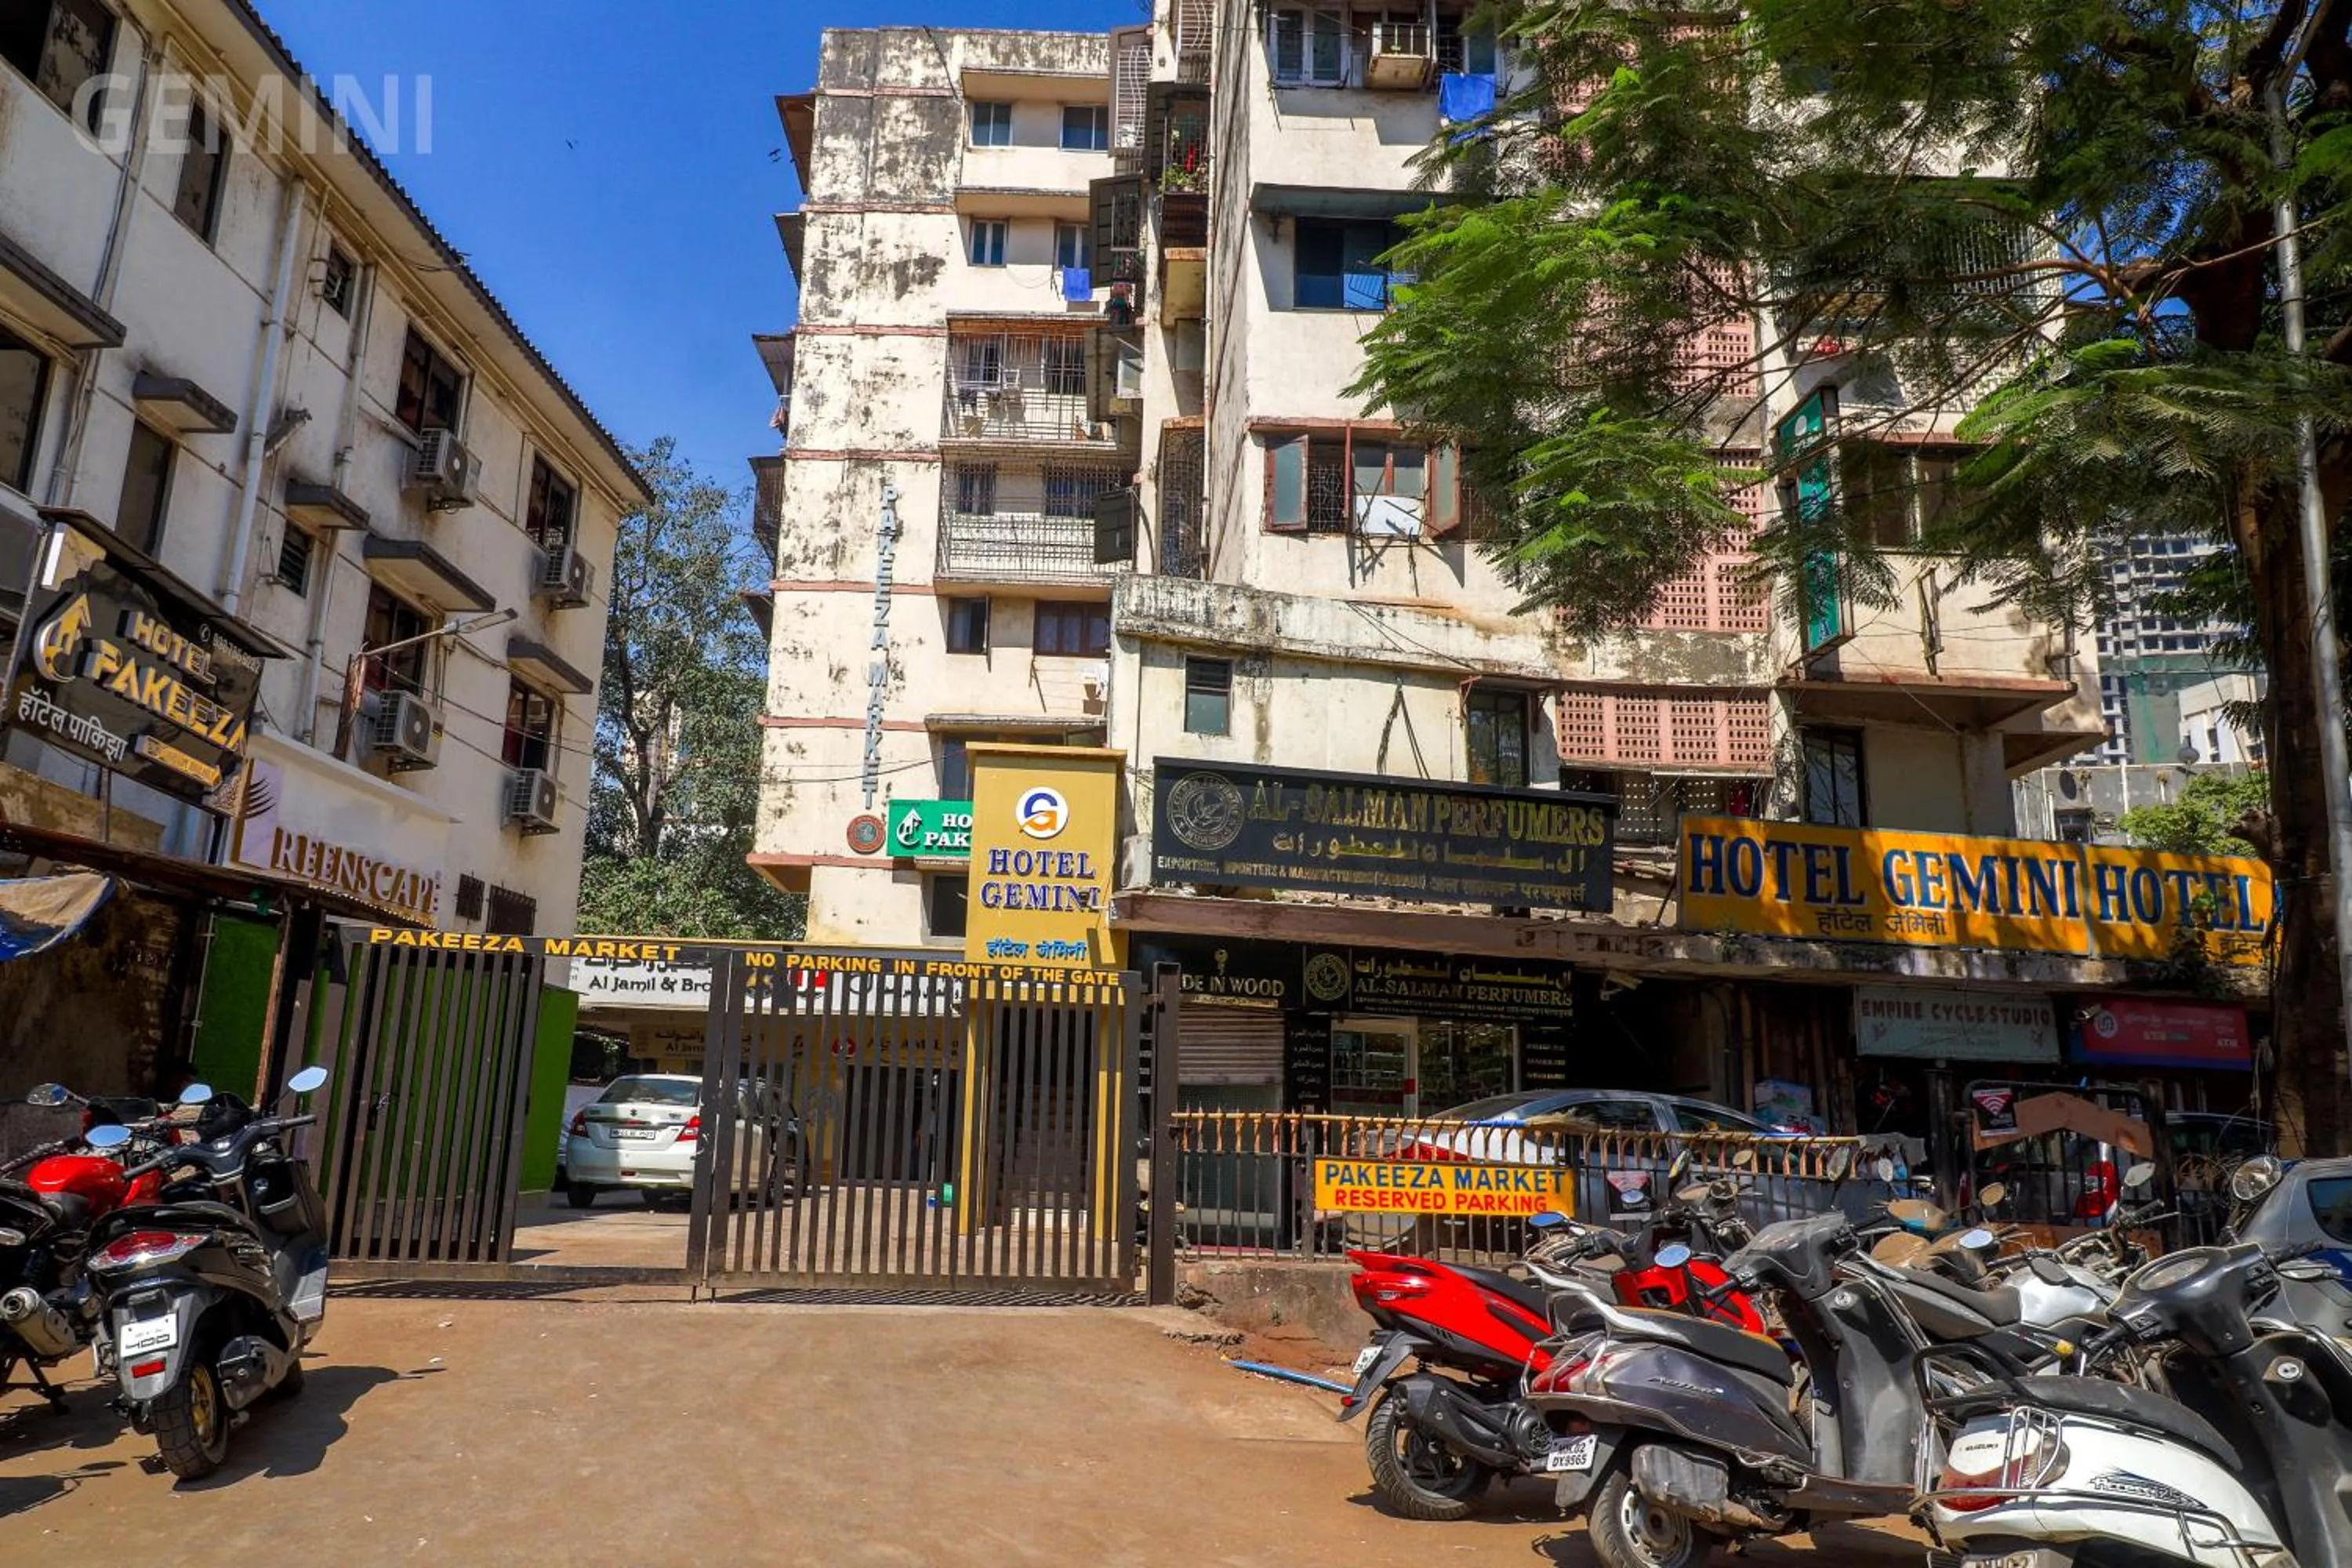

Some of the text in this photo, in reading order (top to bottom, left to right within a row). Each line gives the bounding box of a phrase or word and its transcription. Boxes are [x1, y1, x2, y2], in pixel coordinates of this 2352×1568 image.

[124, 610, 216, 687] HOTEL
[18, 685, 68, 733] हॉटेल
[87, 639, 246, 753] PAKEEZA
[862, 661, 888, 810] MARKET
[1432, 795, 1606, 846] PERFUMERS
[988, 849, 1095, 879] HOTEL
[1688, 833, 2082, 919] HOTEL GEMINI
[981, 881, 1100, 912] GEMINI
[2093, 864, 2266, 931] HOTEL
[1815, 907, 1873, 935] हॉटेल
[371, 928, 681, 960] PAKEEZA MARKET
[589, 975, 607, 989] Al
[612, 976, 656, 993] Jamil
[661, 977, 677, 993] &
[746, 953, 1120, 986] NO PARKING IN FRONT OF THE GATE
[1179, 973, 1285, 996] DE IN WOOD
[1466, 985, 1573, 1007] PERFUMERS
[1861, 1000, 2051, 1026] EMPIRE CYCLE STUDIO
[1324, 1163, 1566, 1194] PAKEEZA MARKET
[1334, 1189, 1548, 1213] RESERVED PARKING
